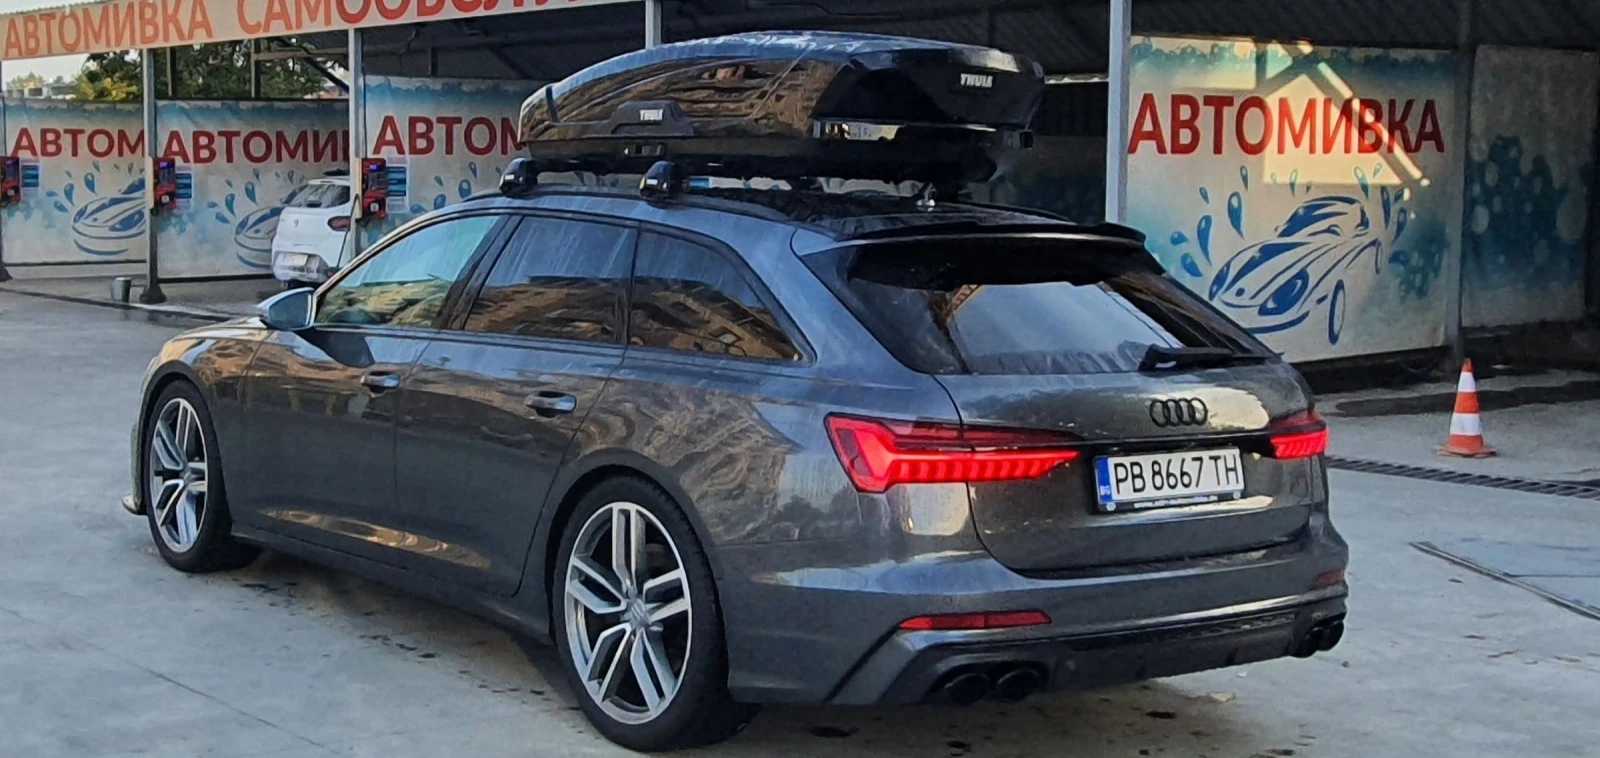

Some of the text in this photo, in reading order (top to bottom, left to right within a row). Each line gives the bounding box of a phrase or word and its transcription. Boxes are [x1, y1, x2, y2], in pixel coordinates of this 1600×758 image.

[4, 0, 213, 57] АВТОМИВКА
[1128, 93, 1444, 155] АВТОМИВКА
[1113, 454, 1239, 494] PB 8667 TH
